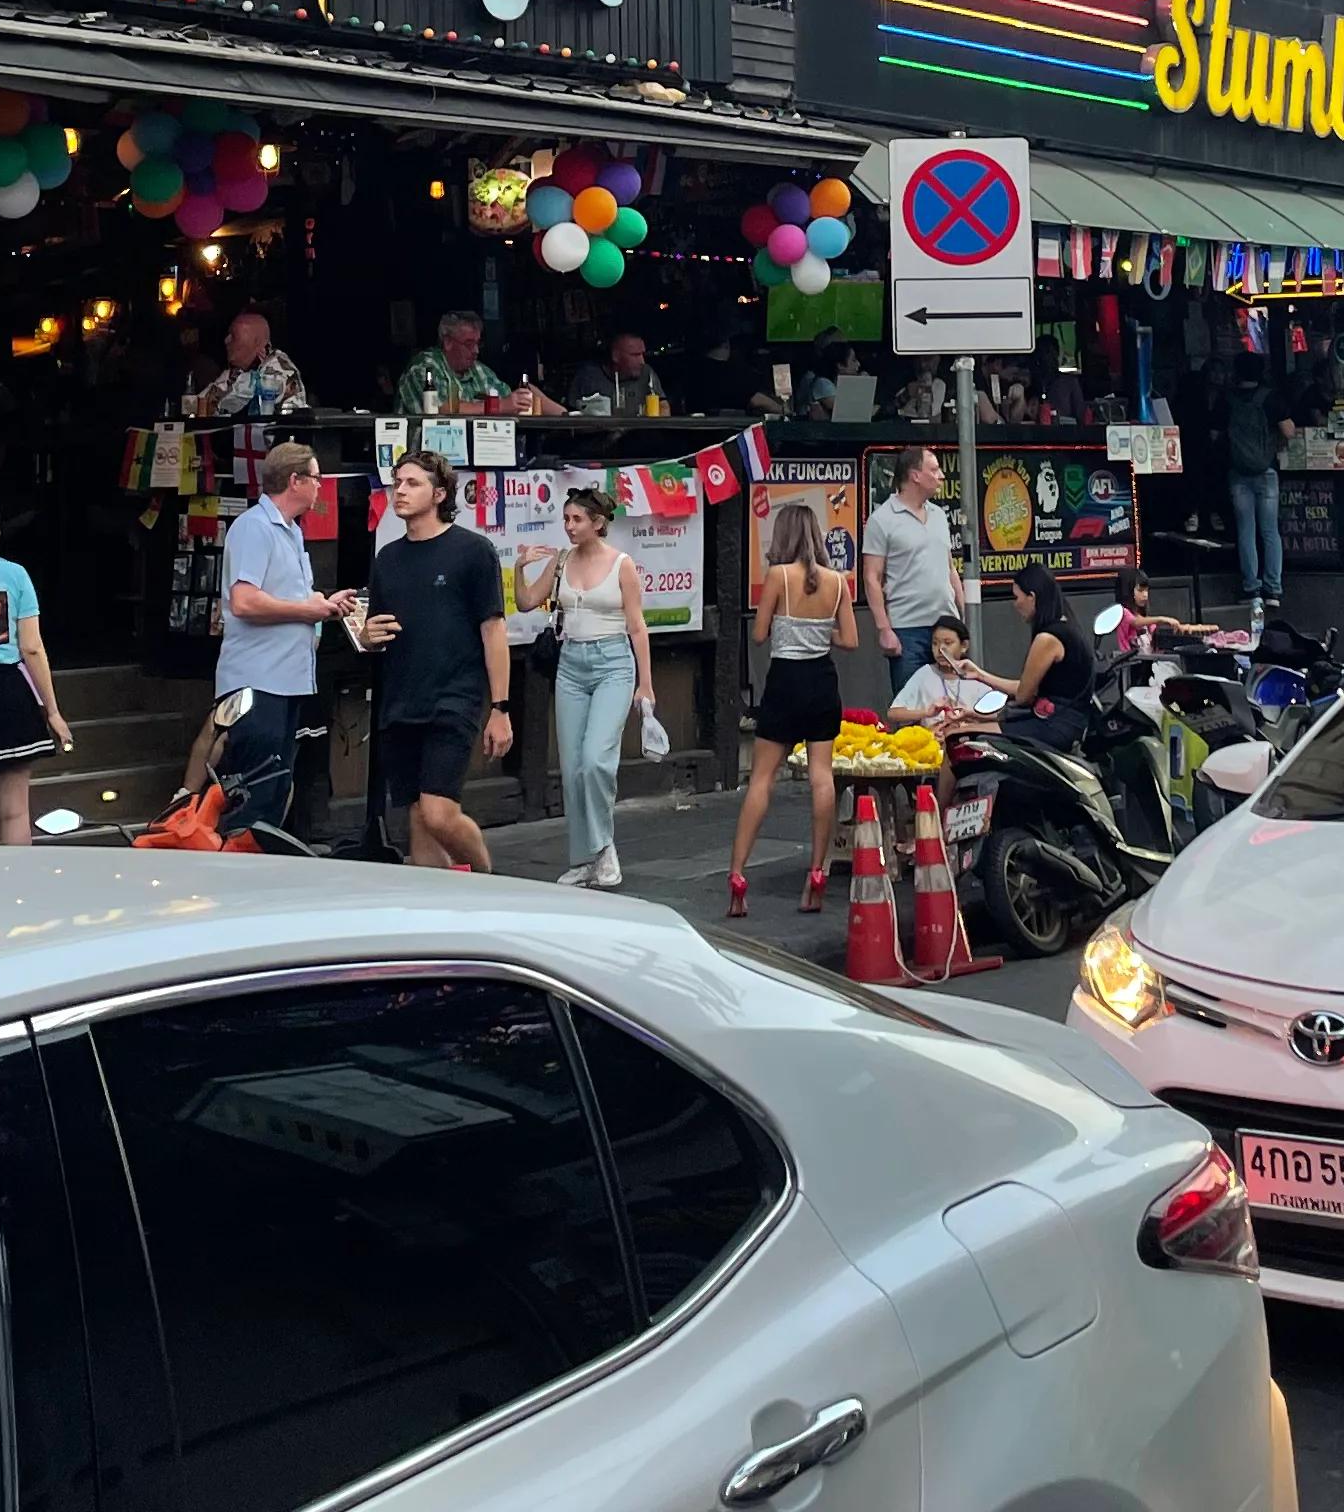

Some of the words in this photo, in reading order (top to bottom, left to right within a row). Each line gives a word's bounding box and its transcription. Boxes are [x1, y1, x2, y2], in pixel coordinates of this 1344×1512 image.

[766, 463, 785, 481] KK
[788, 463, 852, 481] FUNCARD
[1092, 478, 1116, 495] AFL
[1035, 516, 1063, 528] Premier
[656, 526, 683, 538] Hillary
[1035, 528, 1063, 544] League
[1048, 551, 1073, 569] LATE
[1251, 1145, 1313, 1183] 4กอ
